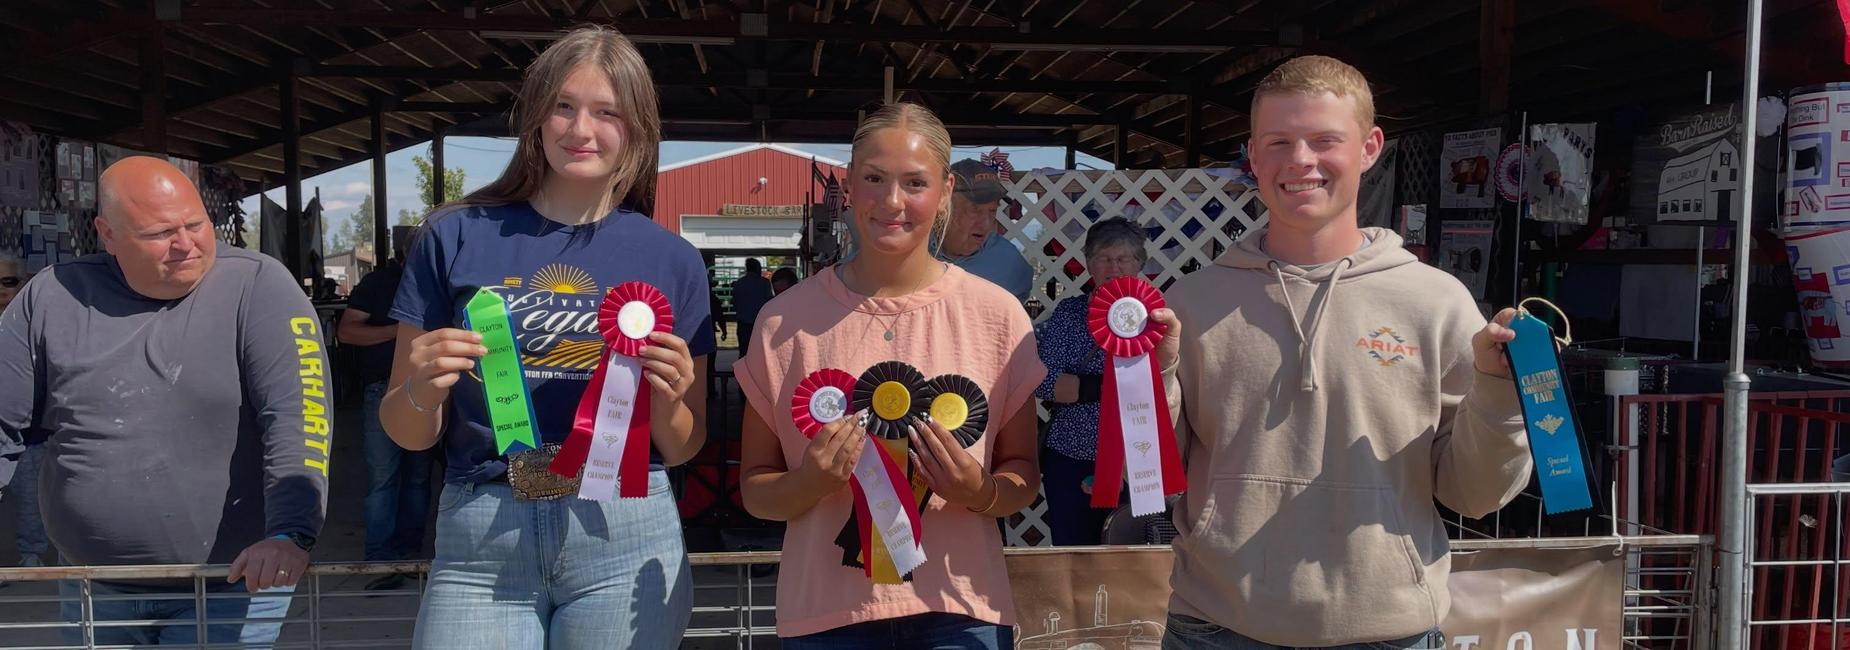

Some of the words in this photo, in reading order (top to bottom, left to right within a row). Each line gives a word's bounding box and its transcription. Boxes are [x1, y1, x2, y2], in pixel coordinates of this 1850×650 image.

[1660, 123, 1690, 145] Barn
[1690, 103, 1736, 136] Raised
[1563, 127, 1593, 159] PARTS
[726, 205, 779, 216] LIVESTOCK
[783, 206, 803, 216] BAR
[507, 294, 596, 308] ULTIVAT
[509, 289, 601, 352] Lega
[479, 323, 503, 334] CLAYTON
[1355, 336, 1419, 357] ARIAT
[496, 370, 509, 379] FAIR
[524, 370, 540, 378] TON
[1521, 368, 1558, 386] CLAYTON
[289, 316, 330, 478] CARHARTT
[607, 396, 629, 407] Clayton
[1533, 389, 1556, 404] FAIR
[1126, 402, 1150, 413] Clayton
[496, 423, 513, 432] SPECIAL
[514, 420, 529, 429] AWARD
[1547, 454, 1569, 468] Special
[1549, 466, 1572, 478] Award
[1452, 628, 1599, 650] TON
